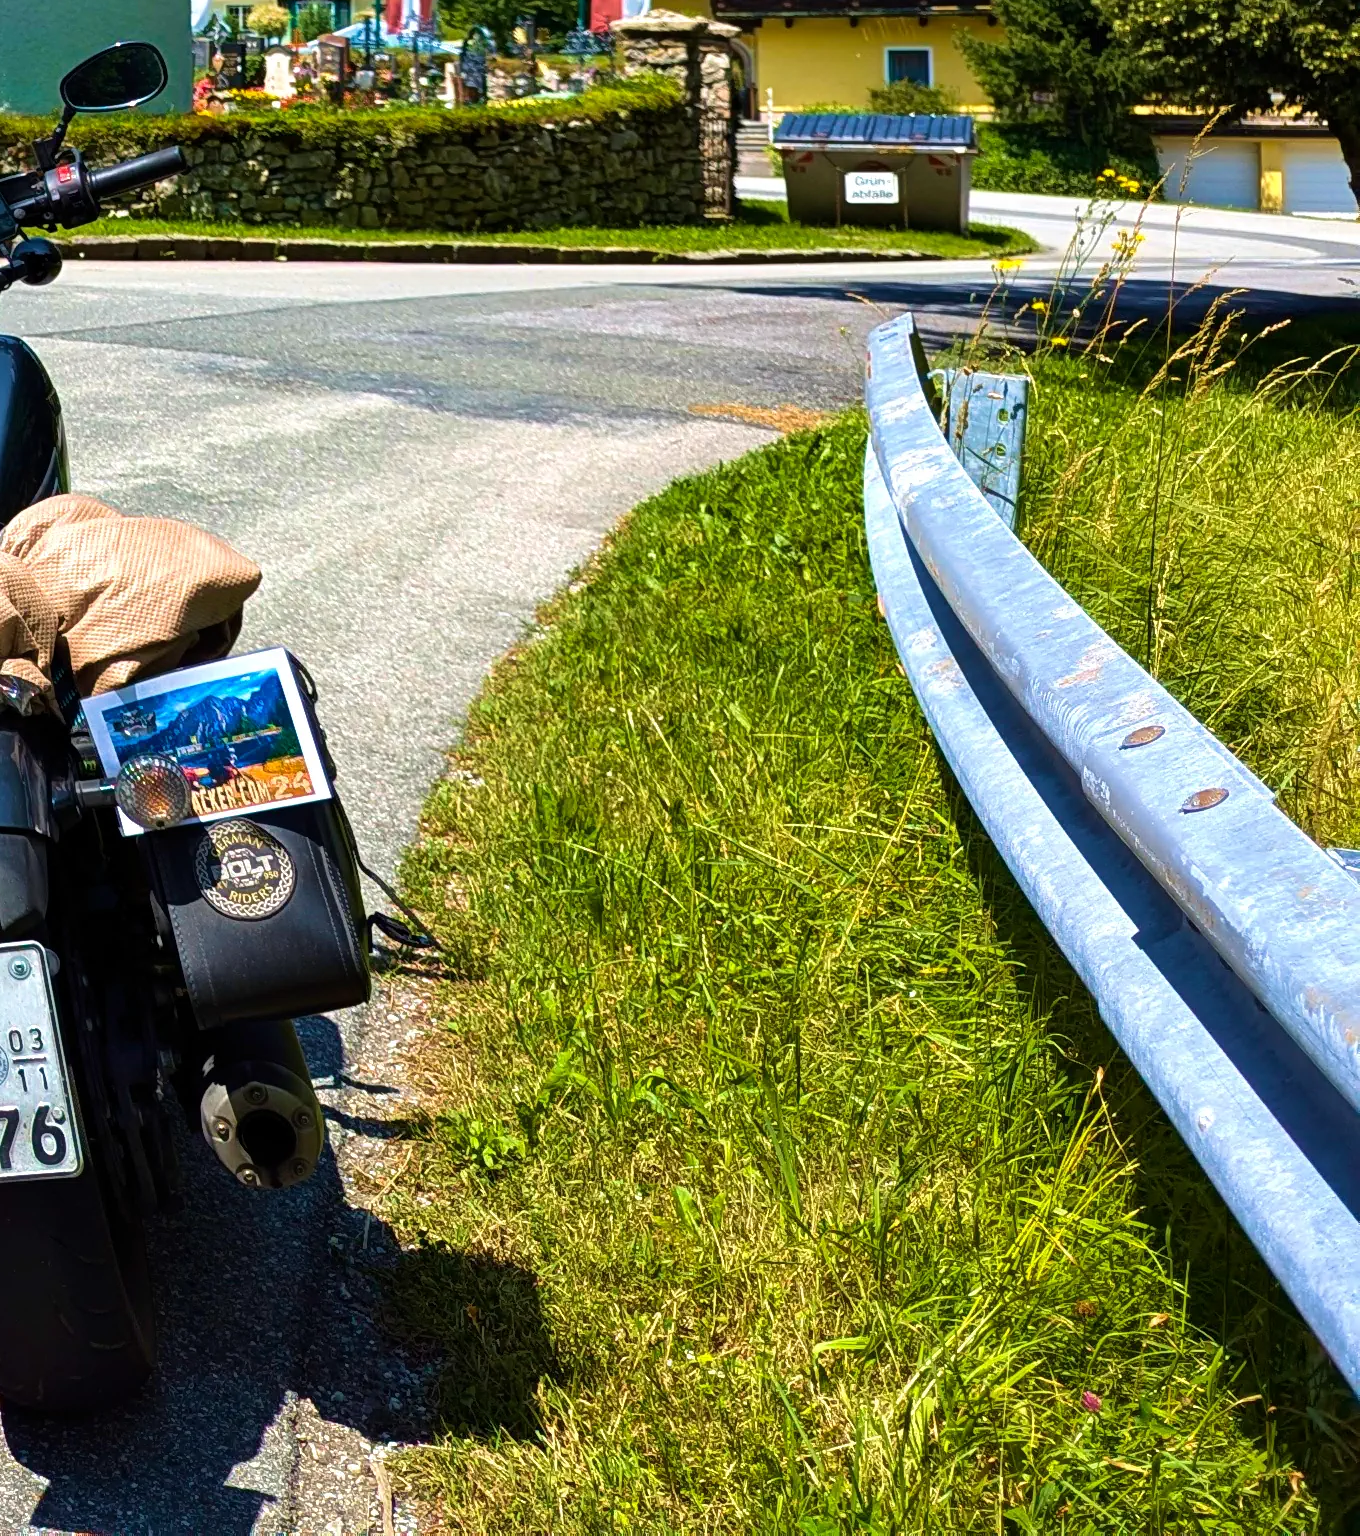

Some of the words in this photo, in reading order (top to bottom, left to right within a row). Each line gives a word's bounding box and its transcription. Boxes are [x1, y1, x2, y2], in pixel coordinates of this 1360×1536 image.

[191, 777, 272, 815] ACKER.COM
[270, 771, 312, 799] 24
[210, 833, 264, 858] GERMAN
[229, 883, 273, 904] RIDERS
[8, 1027, 44, 1053] 03
[17, 1067, 49, 1092] 11
